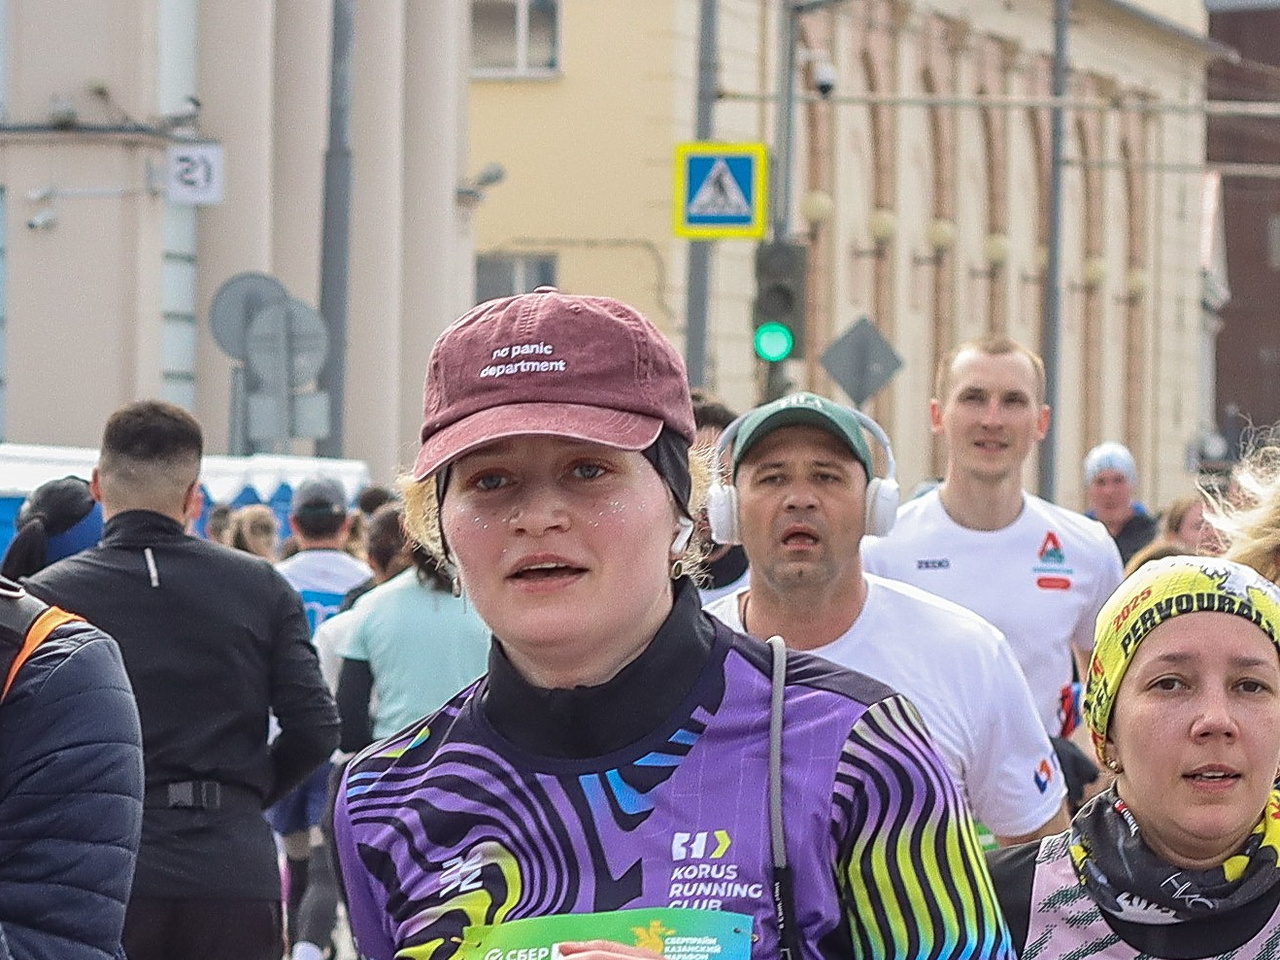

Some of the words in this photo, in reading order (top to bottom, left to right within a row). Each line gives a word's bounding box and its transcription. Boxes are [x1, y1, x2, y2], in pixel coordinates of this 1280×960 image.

[492, 347, 510, 360] no
[511, 342, 553, 359] panic
[480, 359, 566, 378] department
[1114, 586, 1153, 633] 2025
[671, 864, 738, 881] KORUS
[669, 883, 763, 899] RUNNING
